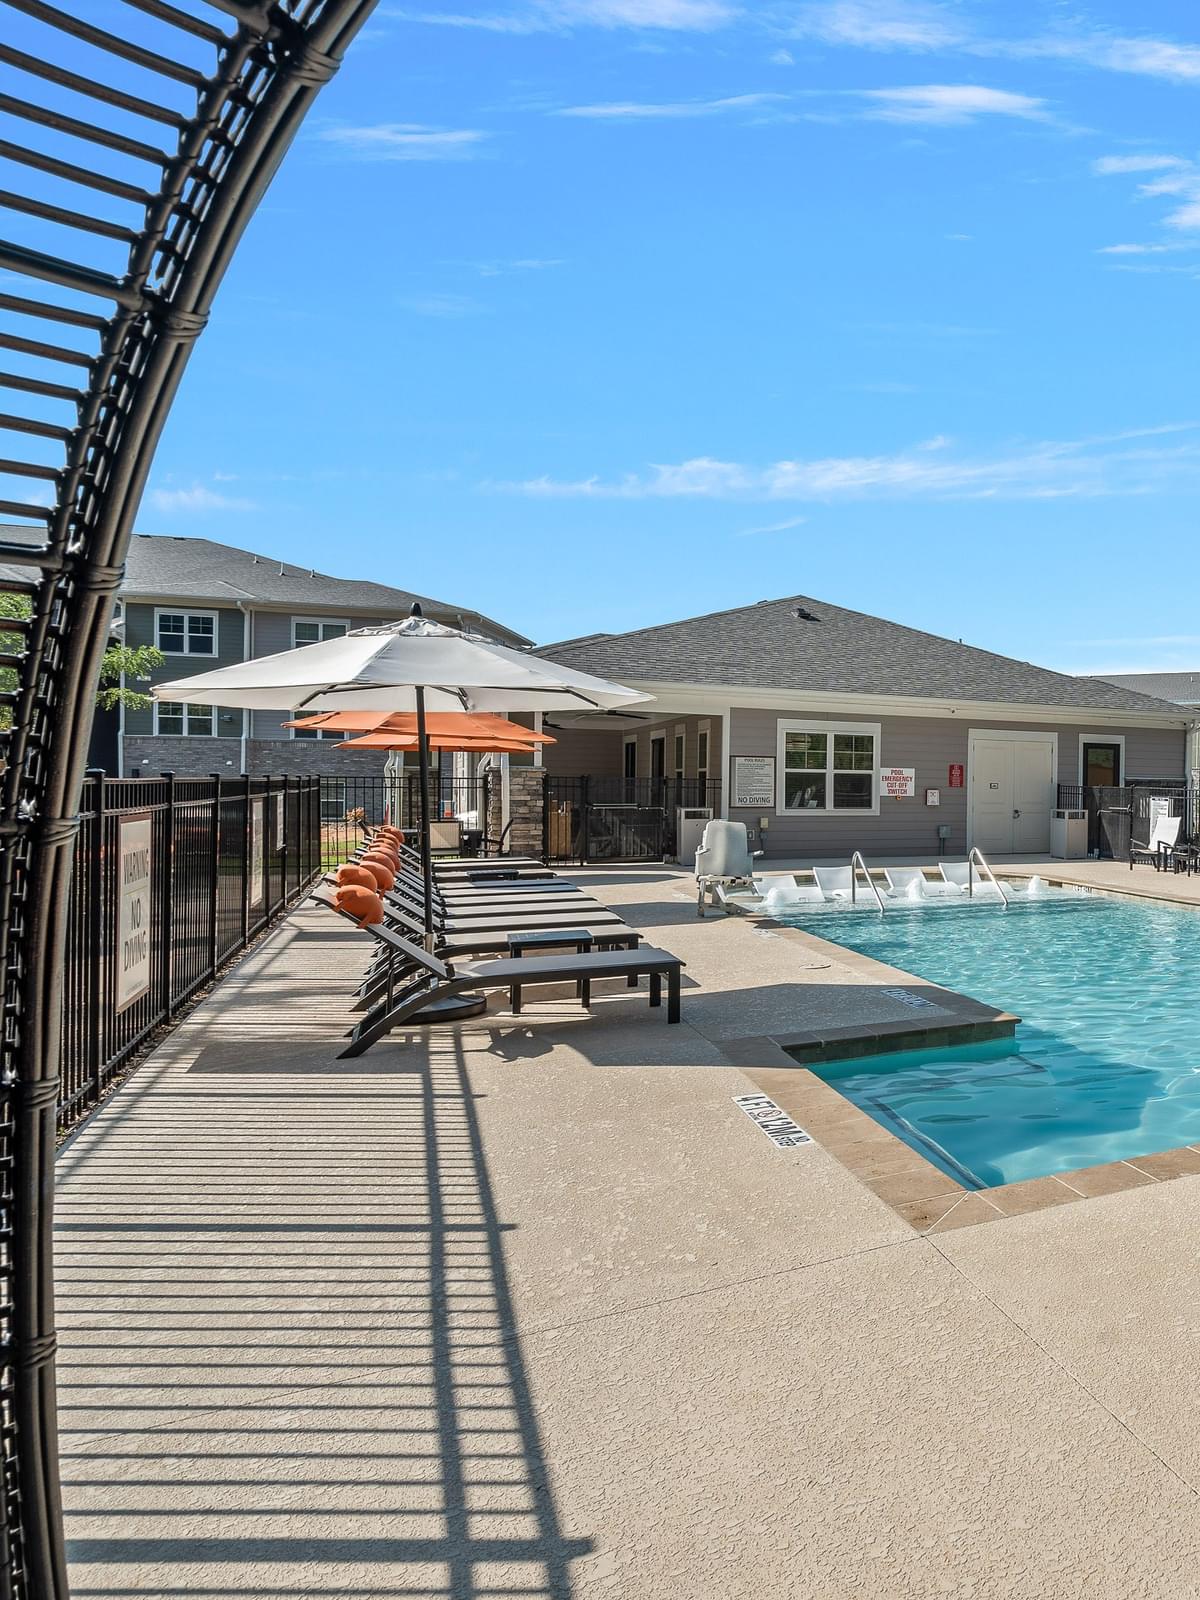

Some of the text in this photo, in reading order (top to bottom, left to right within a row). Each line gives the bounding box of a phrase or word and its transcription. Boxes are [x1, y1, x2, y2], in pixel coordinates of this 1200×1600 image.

[124, 848, 148, 885] WARNING
[131, 898, 141, 930] NO
[124, 930, 146, 971] DIVING
